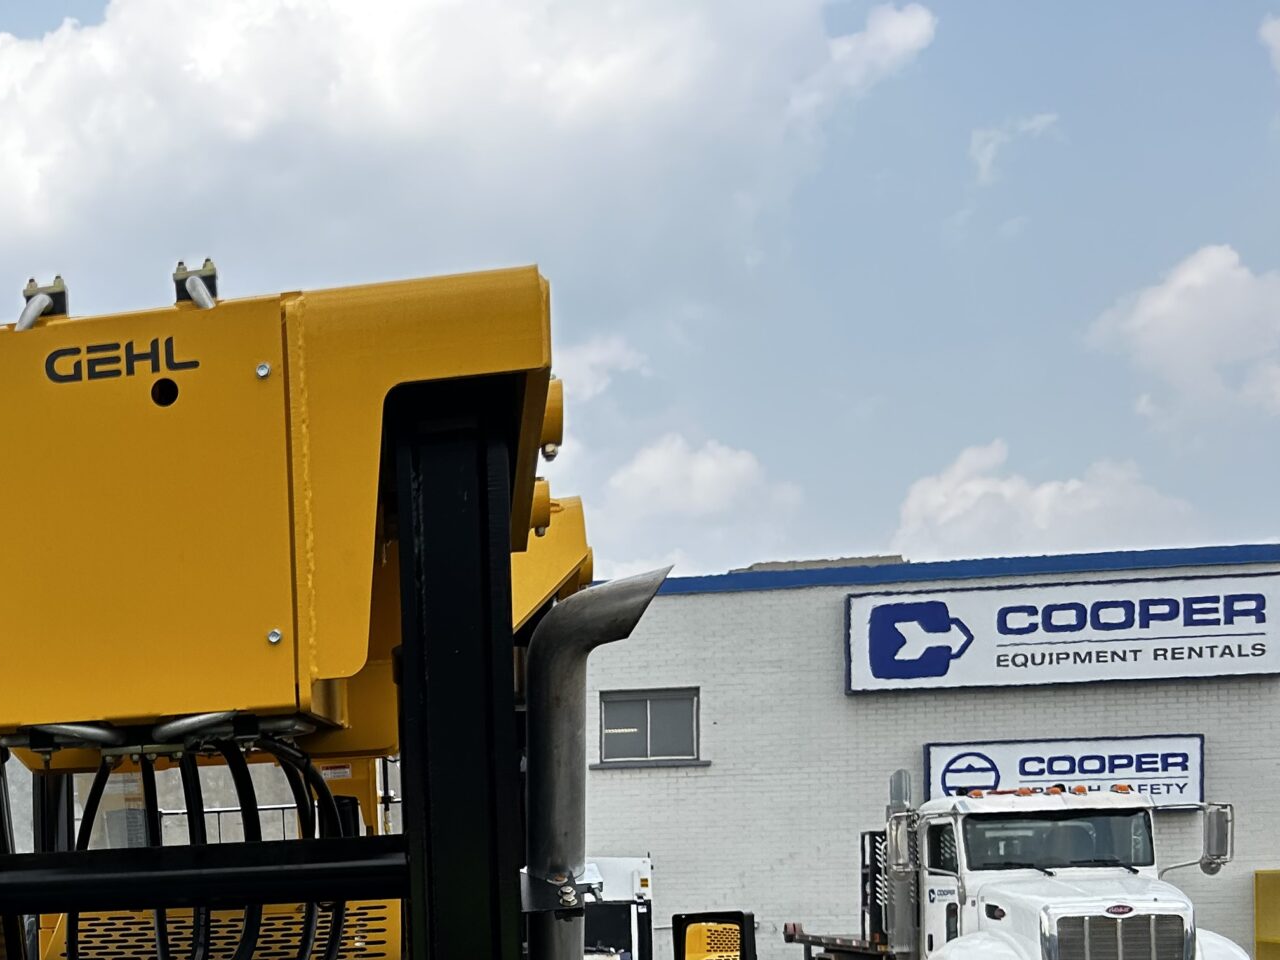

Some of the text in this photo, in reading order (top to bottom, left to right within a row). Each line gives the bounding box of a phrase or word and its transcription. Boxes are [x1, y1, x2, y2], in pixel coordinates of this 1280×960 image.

[45, 336, 200, 383] GEHL
[996, 592, 1267, 636] COOPER
[996, 642, 1267, 669] EQUIPMENT RENTALS
[1018, 752, 1189, 776] COOPER
